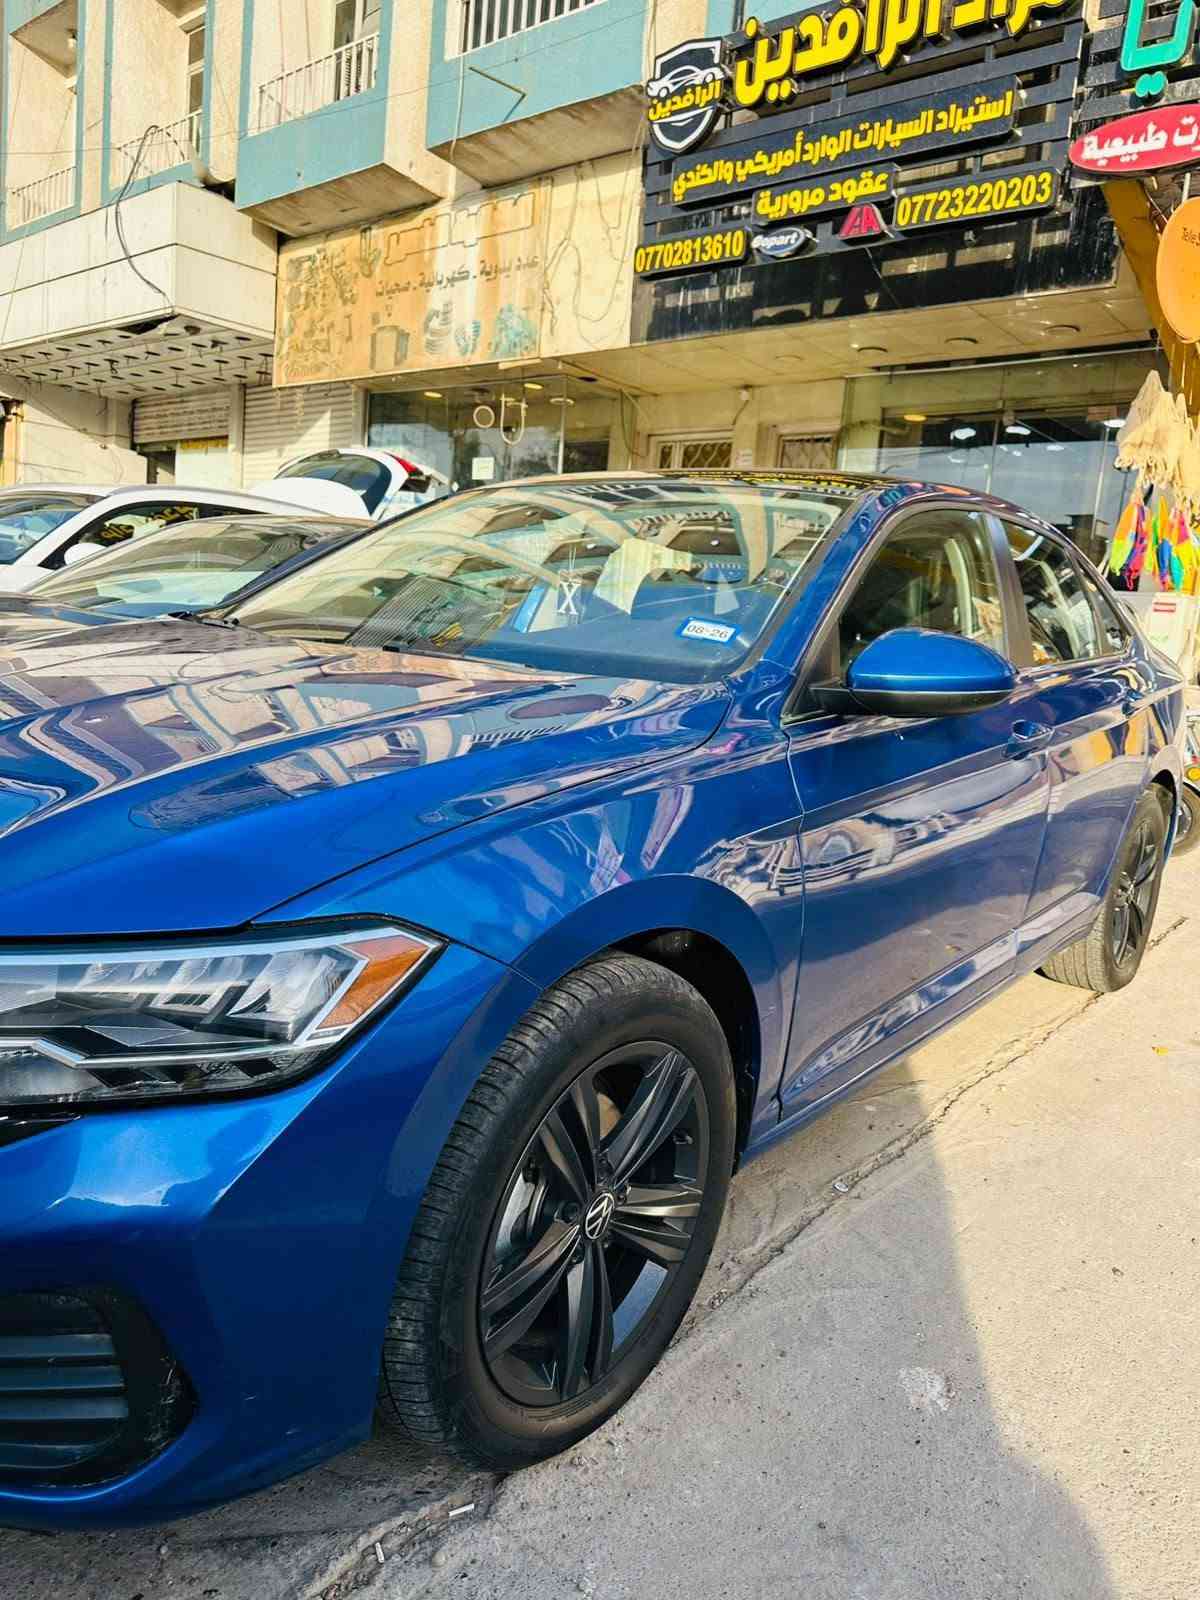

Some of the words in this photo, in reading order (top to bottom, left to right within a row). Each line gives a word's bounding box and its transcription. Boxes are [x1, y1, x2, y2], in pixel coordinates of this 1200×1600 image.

[648, 79, 721, 120] الرافدين
[935, 90, 1013, 134] استيراد
[802, 129, 853, 166] الوارد
[853, 109, 934, 151] السيارات
[1080, 121, 1168, 167] طبيعية
[734, 131, 804, 182] أمريكي
[672, 158, 735, 202] والكندي
[828, 170, 889, 204] عقود
[896, 171, 1053, 226] 07723220203
[756, 189, 826, 219] مرورية
[634, 229, 745, 273] 07702813610
